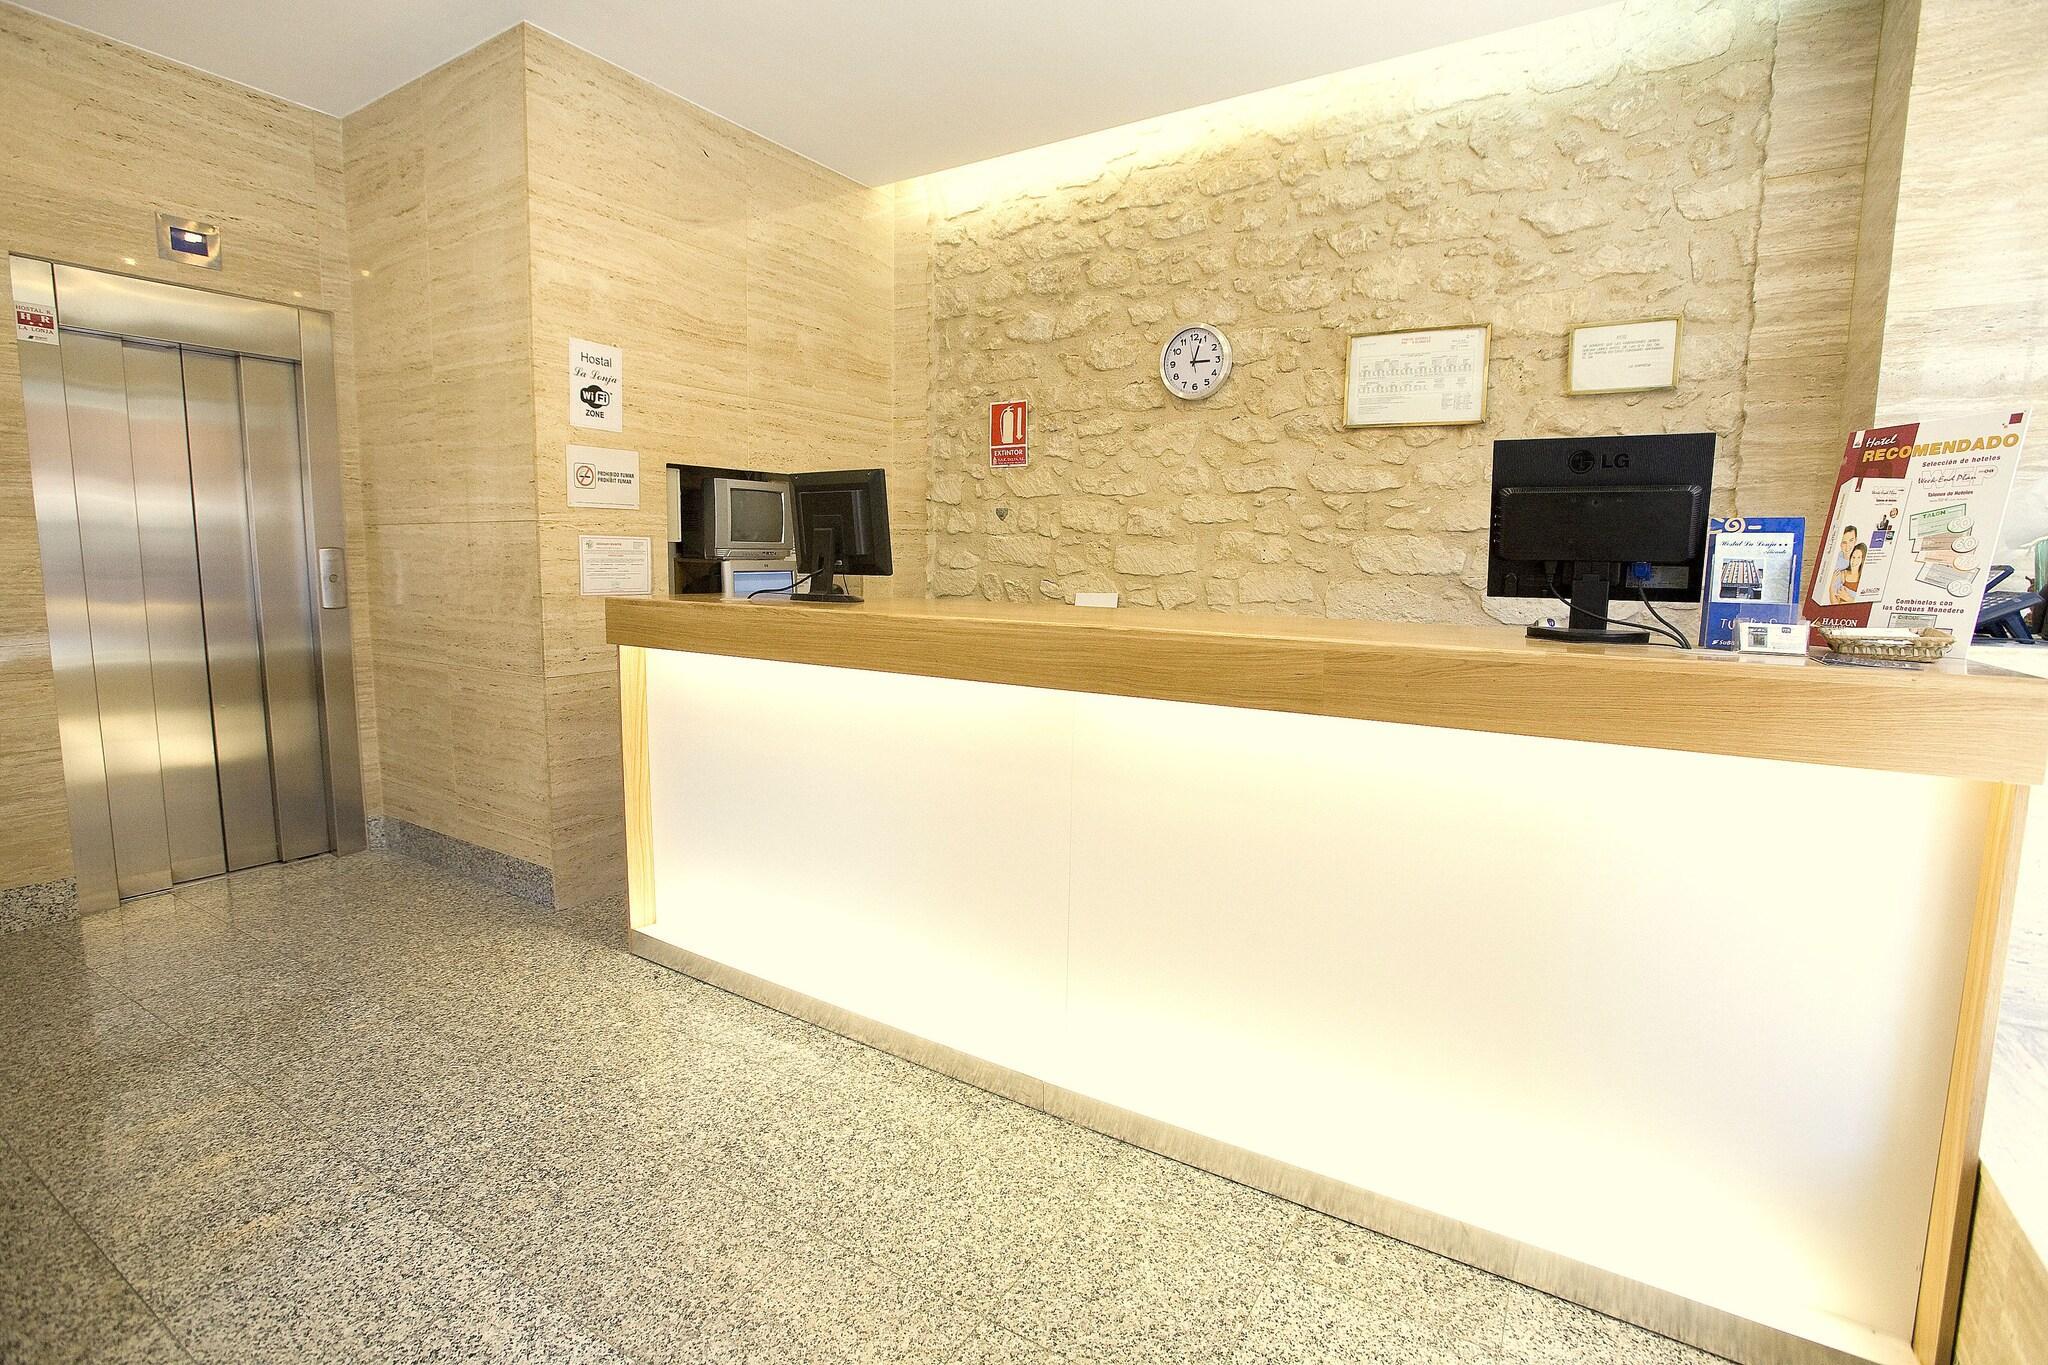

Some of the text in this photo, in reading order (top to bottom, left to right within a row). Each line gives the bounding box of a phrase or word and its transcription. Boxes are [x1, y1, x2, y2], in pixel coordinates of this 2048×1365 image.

[16, 304, 43, 313] HOSTAL
[1181, 338, 1187, 346] 11
[1211, 343, 1218, 351] 2
[1172, 348, 1181, 356] 10
[580, 351, 612, 368] Hostal
[1215, 355, 1221, 363] 3
[573, 366, 617, 385] La Lonja
[1181, 381, 1187, 389] 7
[1204, 378, 1210, 386] 5
[585, 409, 605, 418] ZONE
[1866, 434, 1897, 448] Hotel
[1862, 433, 2020, 463] RECOMENDADO
[1601, 453, 1630, 468] LG
[1971, 454, 2001, 463] hoteles
[1927, 606, 1965, 614] Monedero
[1822, 617, 1858, 627] HALCON
